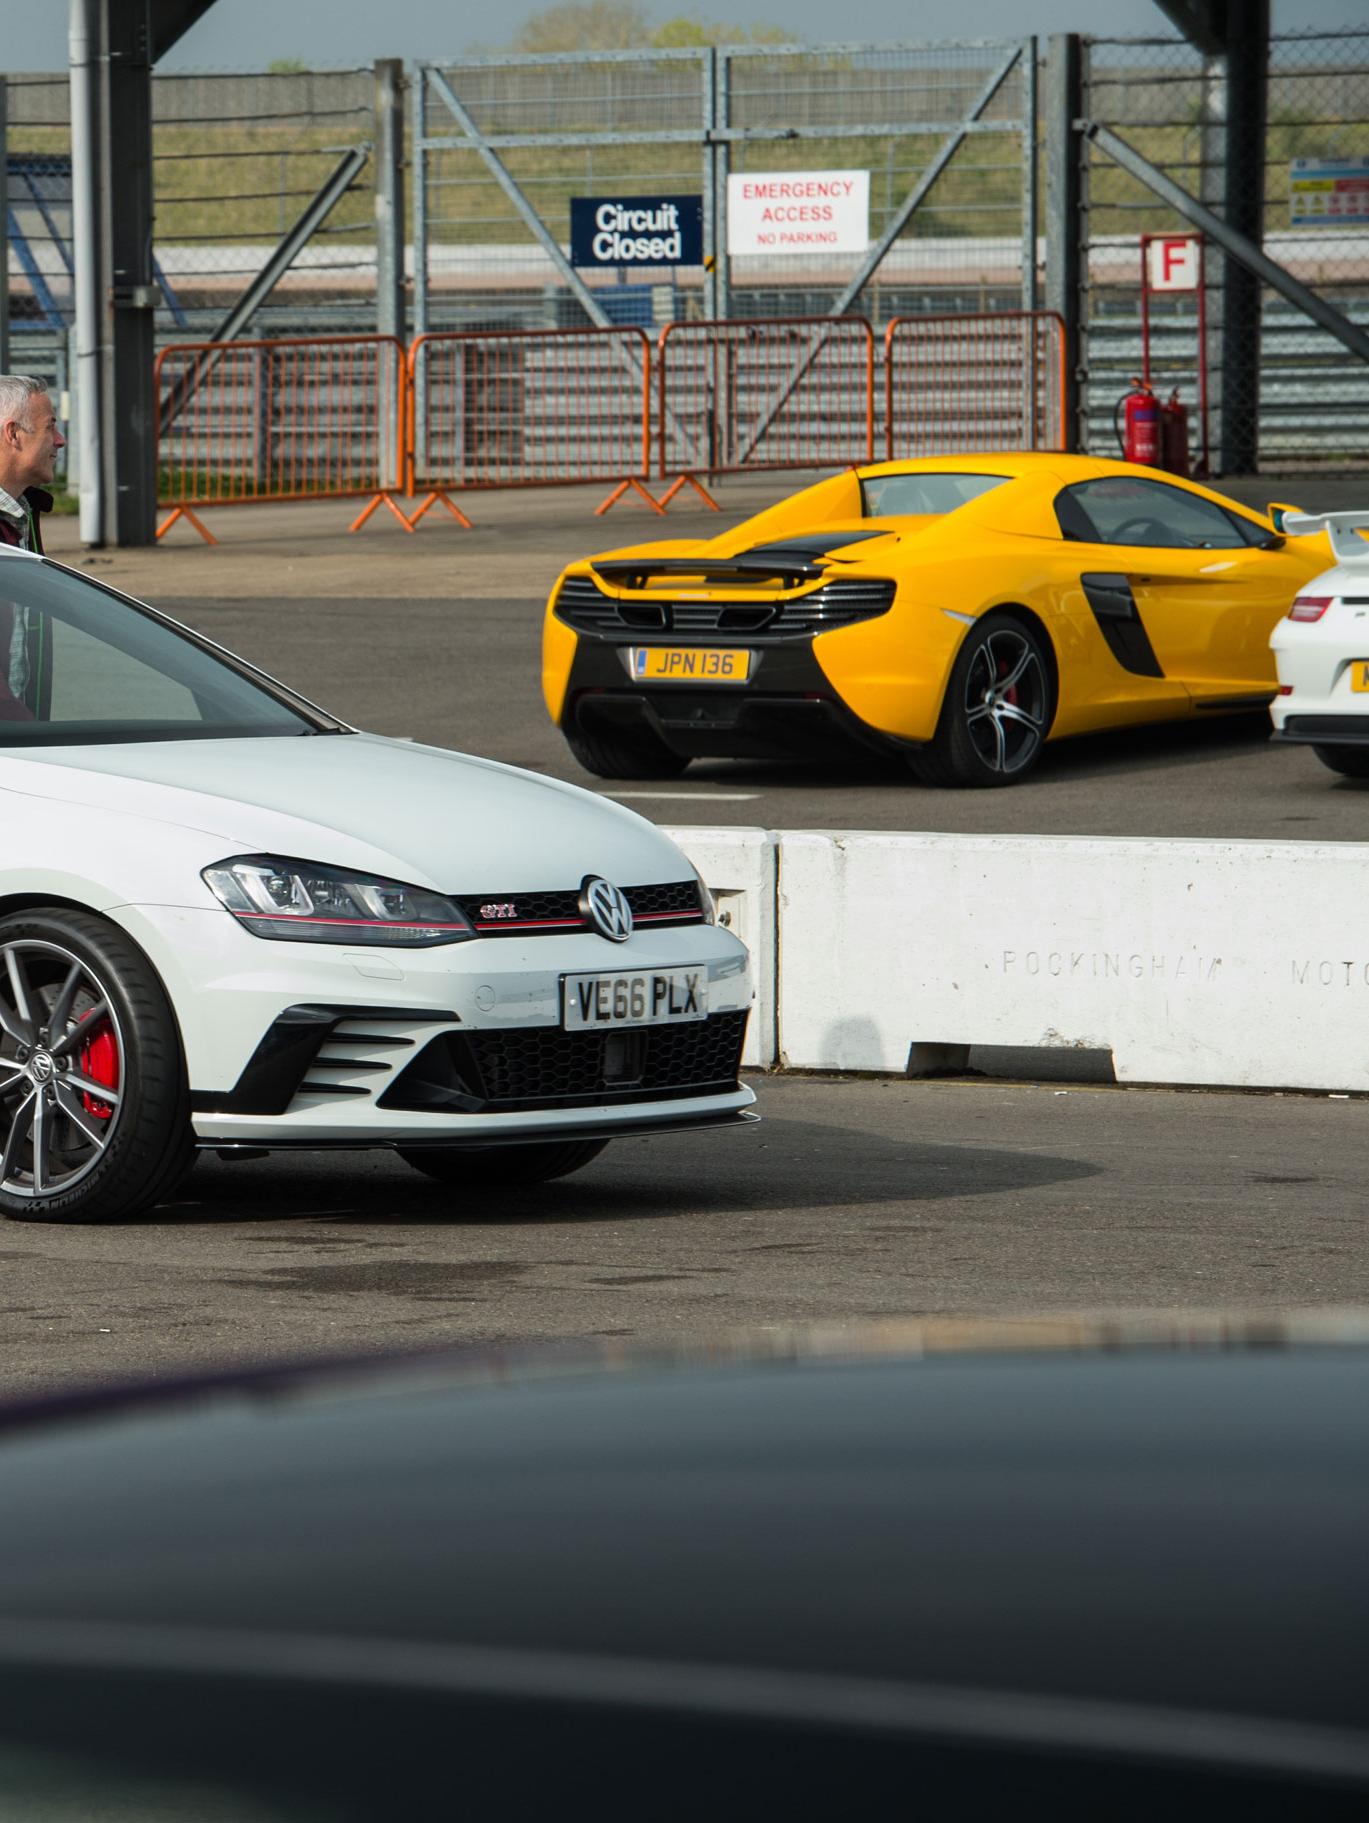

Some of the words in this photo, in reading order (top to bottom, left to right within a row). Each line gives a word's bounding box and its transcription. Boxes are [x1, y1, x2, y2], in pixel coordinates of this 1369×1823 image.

[743, 181, 854, 199] EMERGENCY
[595, 203, 679, 232] Circuit
[761, 206, 833, 223] ACCESS
[592, 231, 682, 260] Closed
[757, 233, 776, 245] NO
[780, 231, 838, 244] PARKING
[1163, 241, 1187, 282] F
[656, 652, 696, 674] JPN
[701, 653, 734, 675] 136
[480, 904, 518, 919] GTI
[577, 978, 645, 1022] VE66
[652, 973, 700, 1017] PLX
